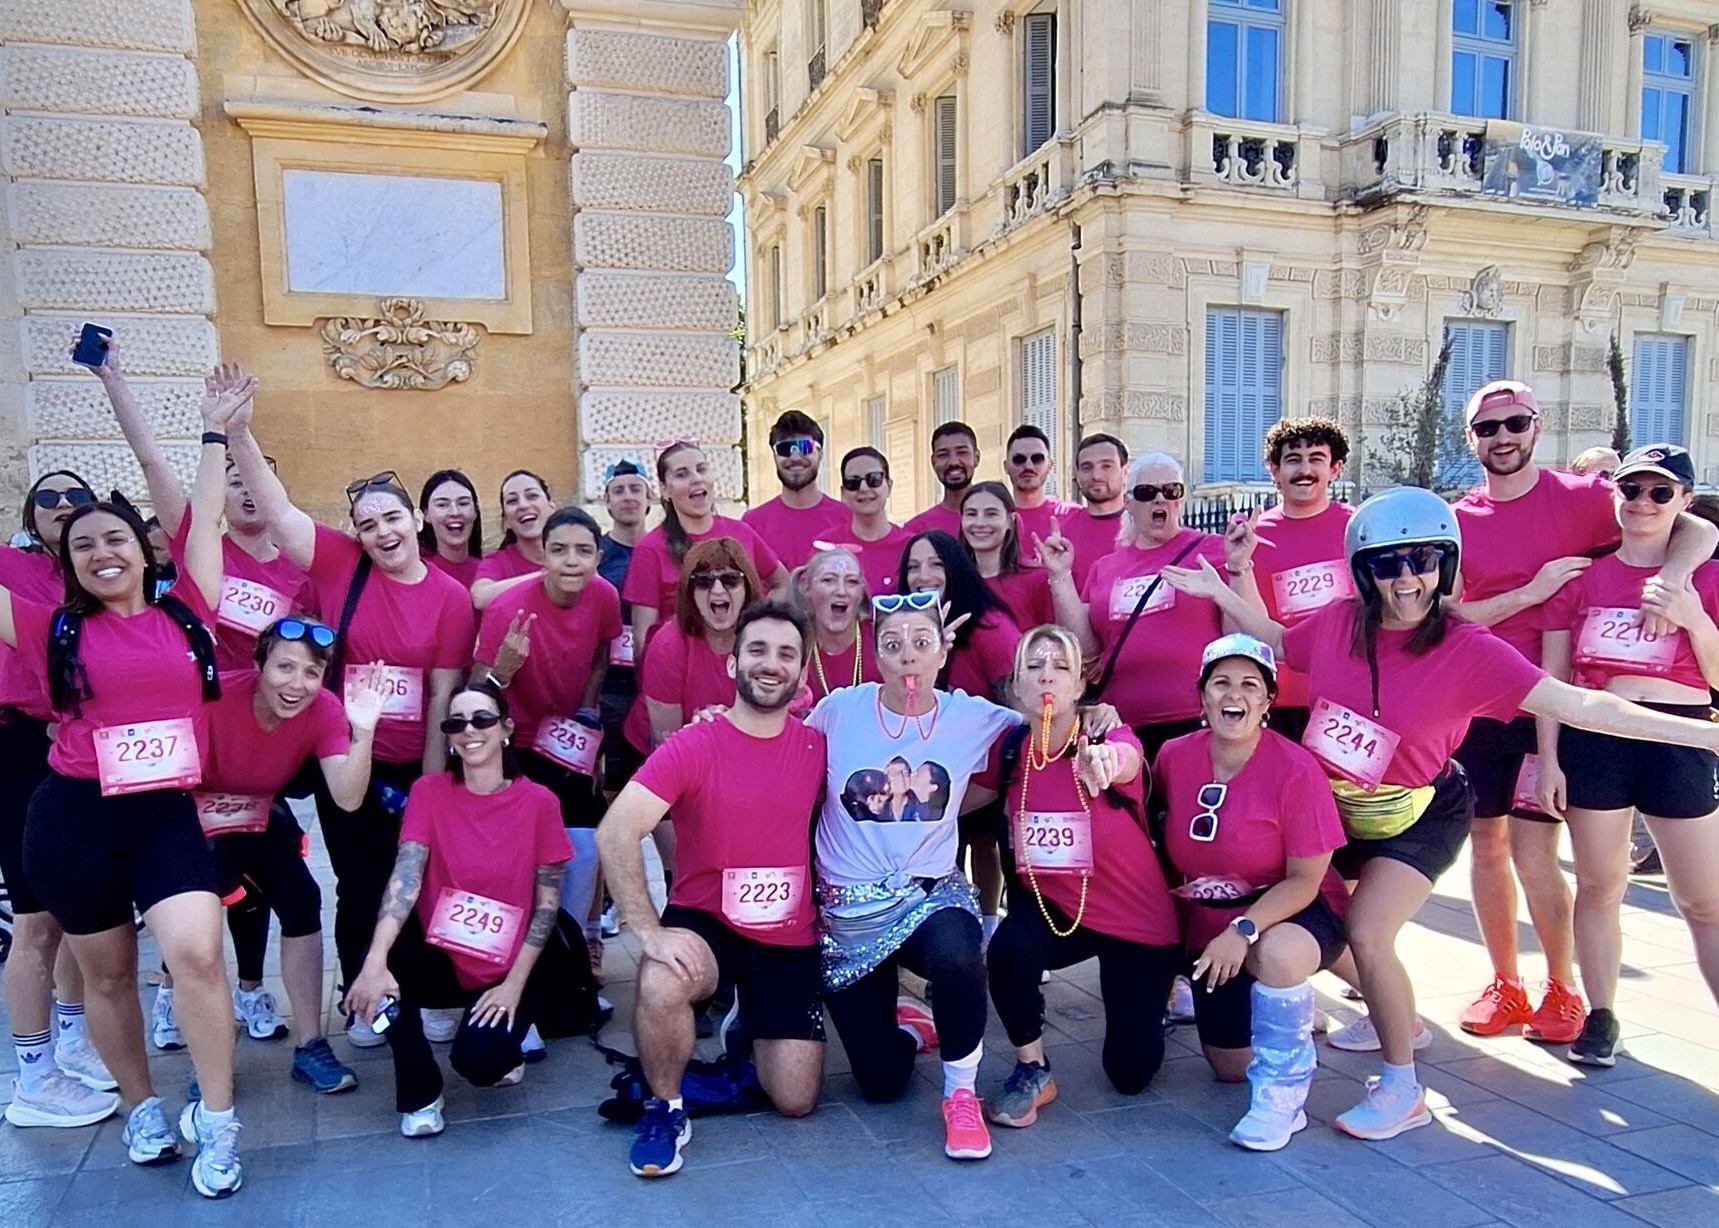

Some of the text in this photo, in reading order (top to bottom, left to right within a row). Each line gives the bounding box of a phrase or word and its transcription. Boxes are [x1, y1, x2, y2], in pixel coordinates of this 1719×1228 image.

[1287, 572, 1335, 597] 2229
[225, 587, 275, 616] 2230
[116, 735, 178, 762] 2237
[549, 722, 587, 751] 2243
[1323, 718, 1377, 758] 2244
[1026, 826, 1074, 847] 2239
[739, 882, 791, 903] 2223
[449, 904, 504, 934] 2249
